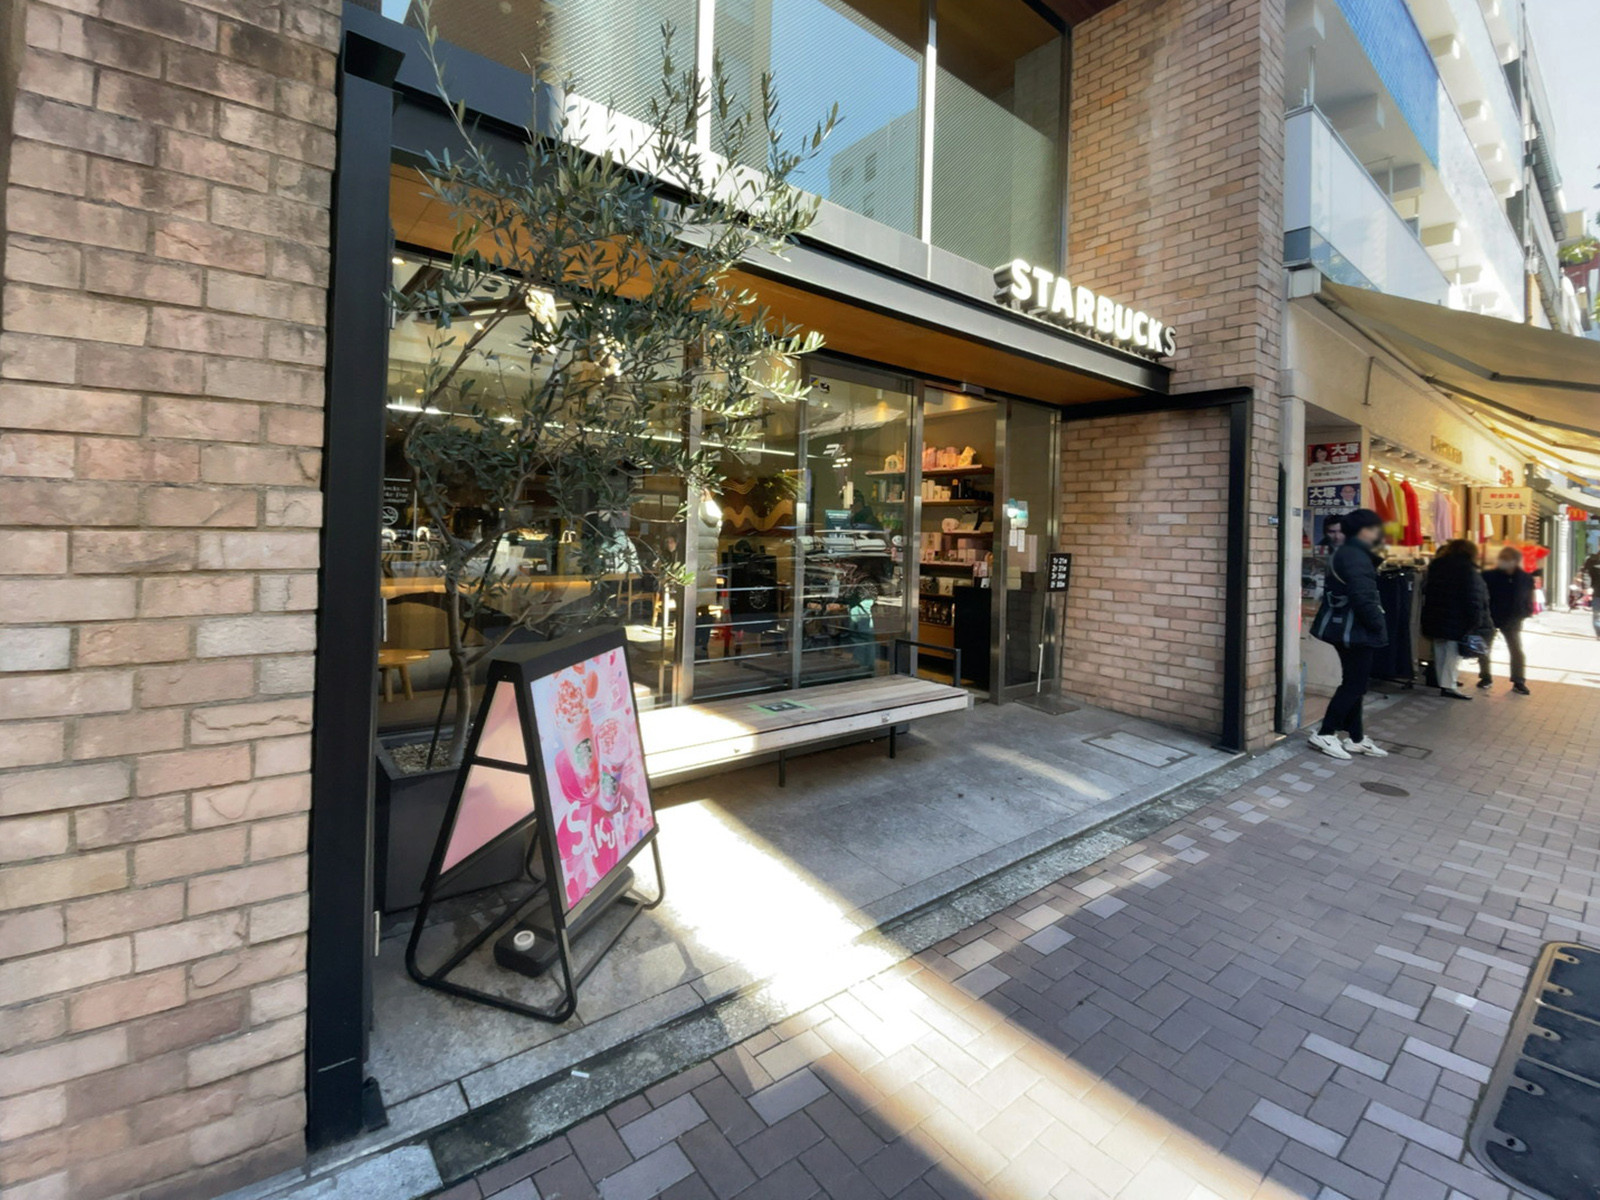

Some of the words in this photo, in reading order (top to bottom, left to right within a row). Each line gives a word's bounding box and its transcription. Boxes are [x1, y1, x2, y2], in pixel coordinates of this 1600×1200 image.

[1007, 258, 1177, 357] STARBUCKS
[1309, 487, 1336, 498] 大塚
[566, 796, 629, 858] SAKURA
